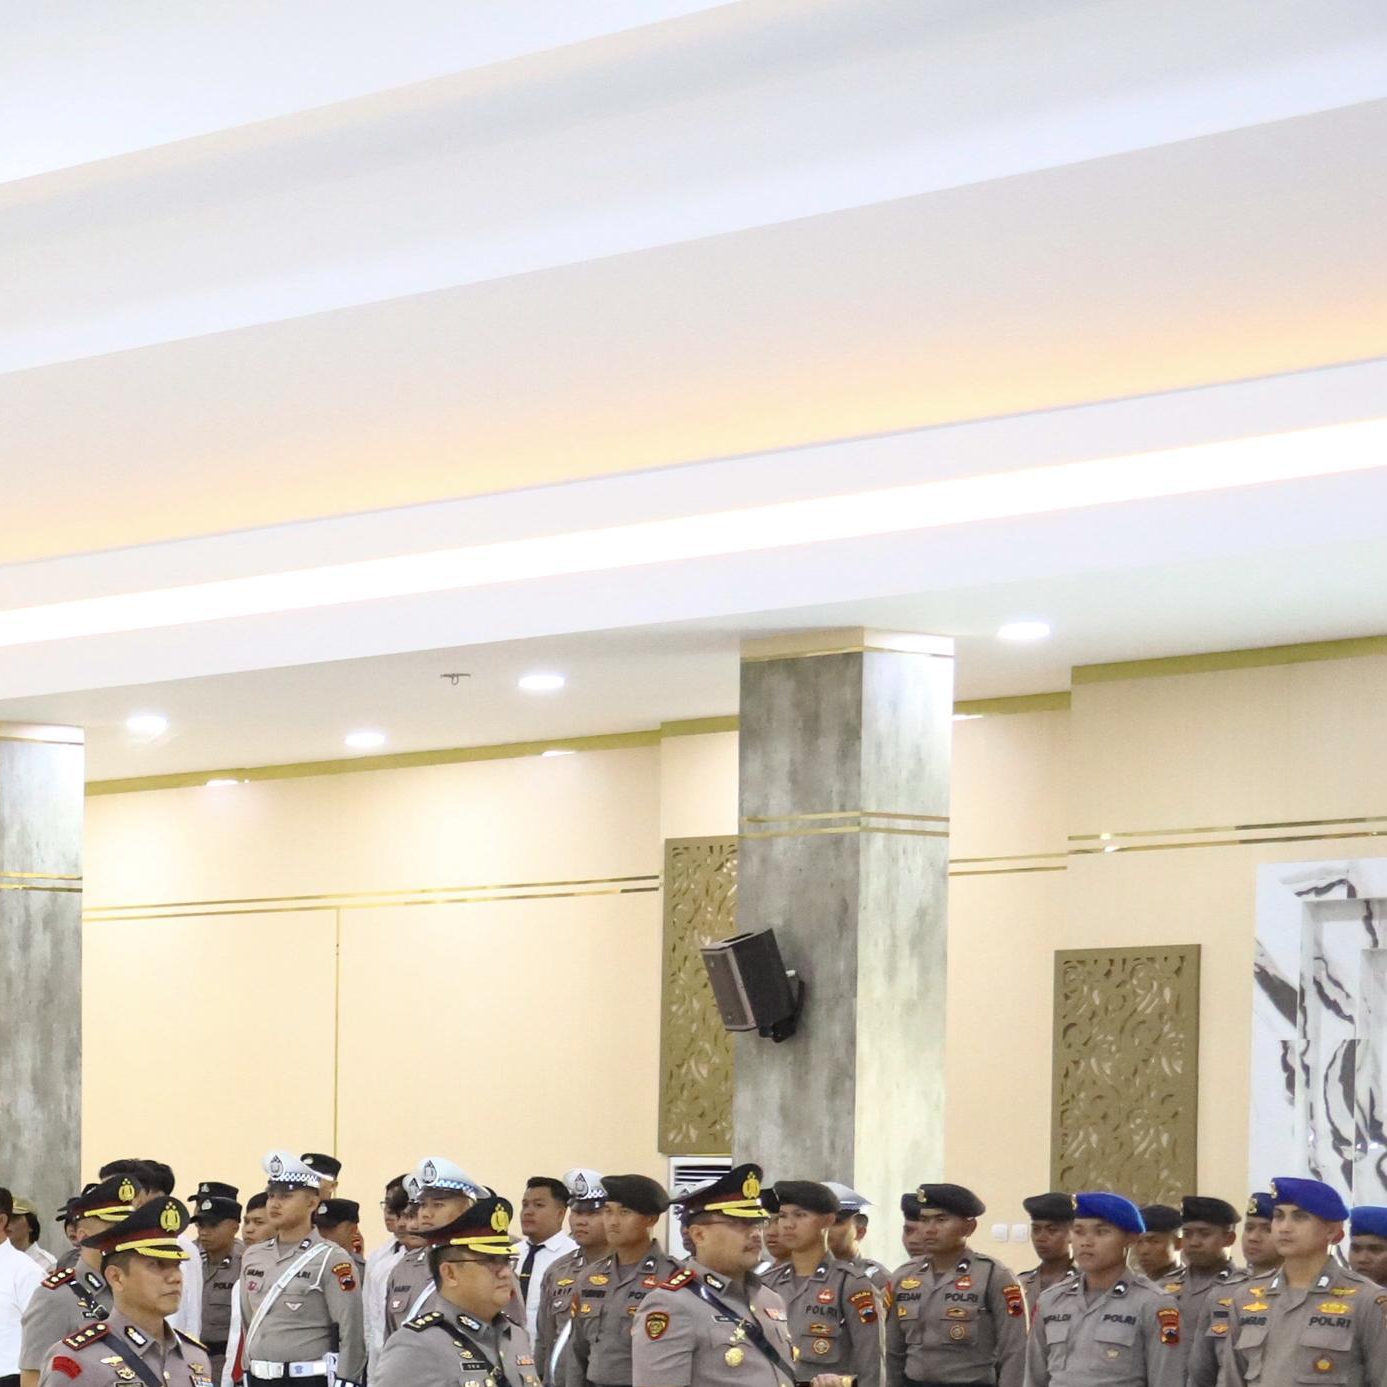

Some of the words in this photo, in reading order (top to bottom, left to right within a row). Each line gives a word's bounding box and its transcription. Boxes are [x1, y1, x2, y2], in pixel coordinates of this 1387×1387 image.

[945, 1293, 978, 1302] POLRI
[806, 1304, 837, 1317] POLRI
[1103, 1314, 1136, 1325] POLRI
[1309, 1316, 1351, 1328] POLRI
